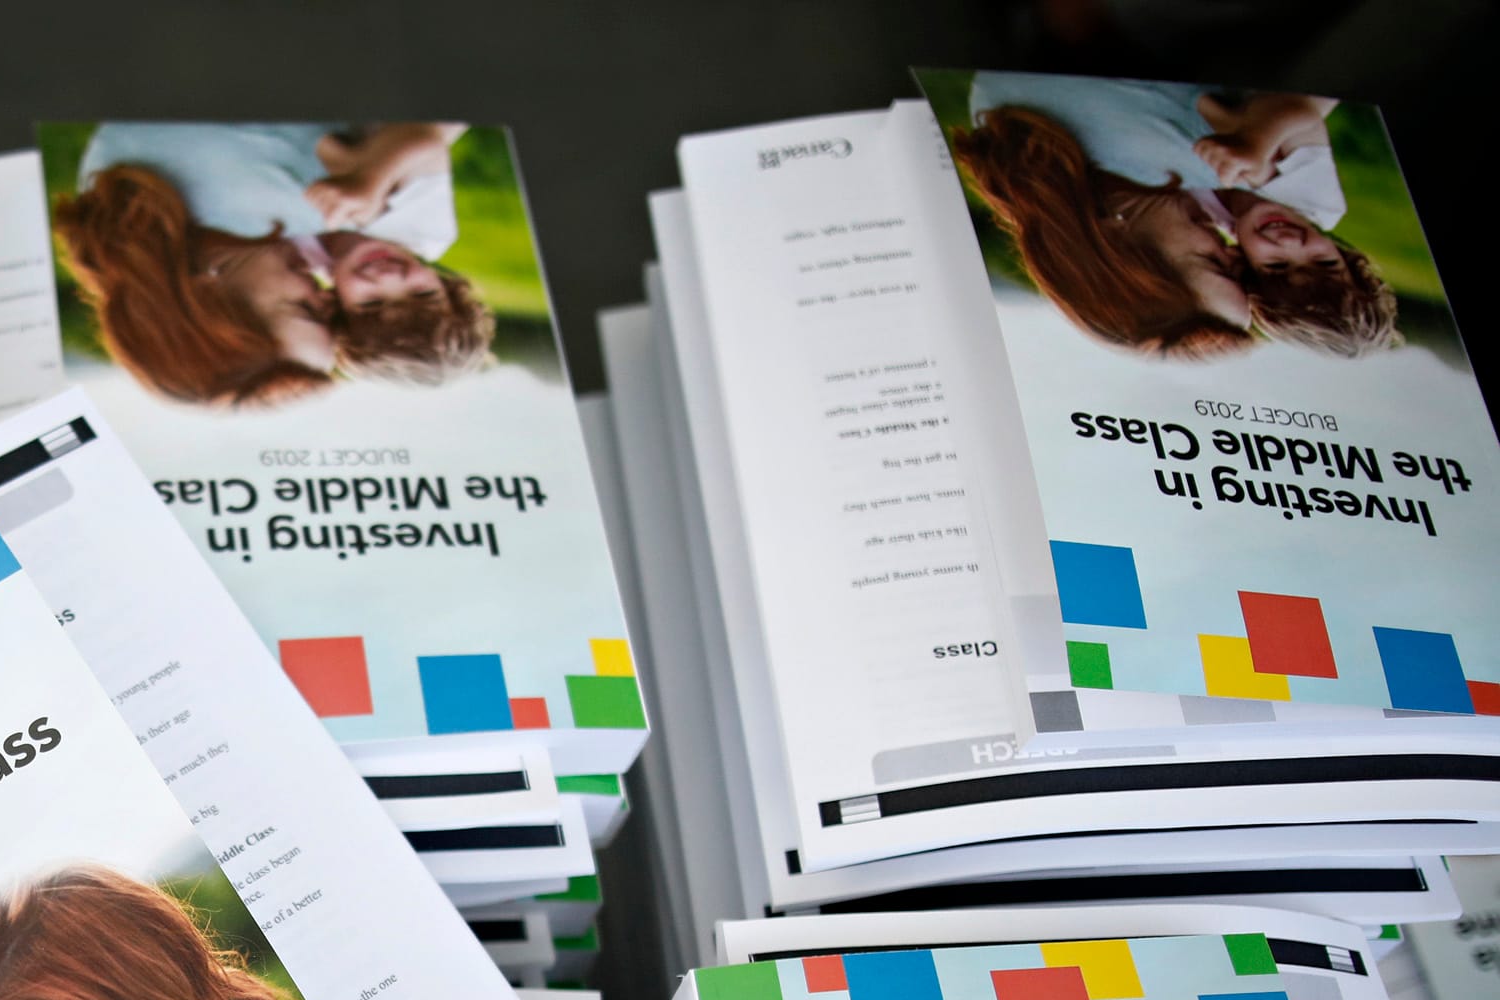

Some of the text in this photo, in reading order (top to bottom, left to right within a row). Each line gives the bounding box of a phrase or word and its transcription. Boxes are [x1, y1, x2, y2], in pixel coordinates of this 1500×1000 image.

[1194, 399, 1339, 432] BUDGET 2019
[259, 448, 410, 466] BUDGET 2019
[1069, 411, 1472, 495] the Middle Class
[153, 475, 548, 516] the Middle Clas
[1153, 466, 1438, 537] Investing in
[206, 515, 500, 562] Investing in
[932, 640, 998, 659] Class
[116, 659, 181, 705] young people
[147, 710, 191, 743] their age
[179, 739, 230, 778] much they
[200, 803, 219, 820] big
[245, 826, 278, 847] Class.
[242, 845, 301, 886] class began
[273, 887, 323, 925] of a better
